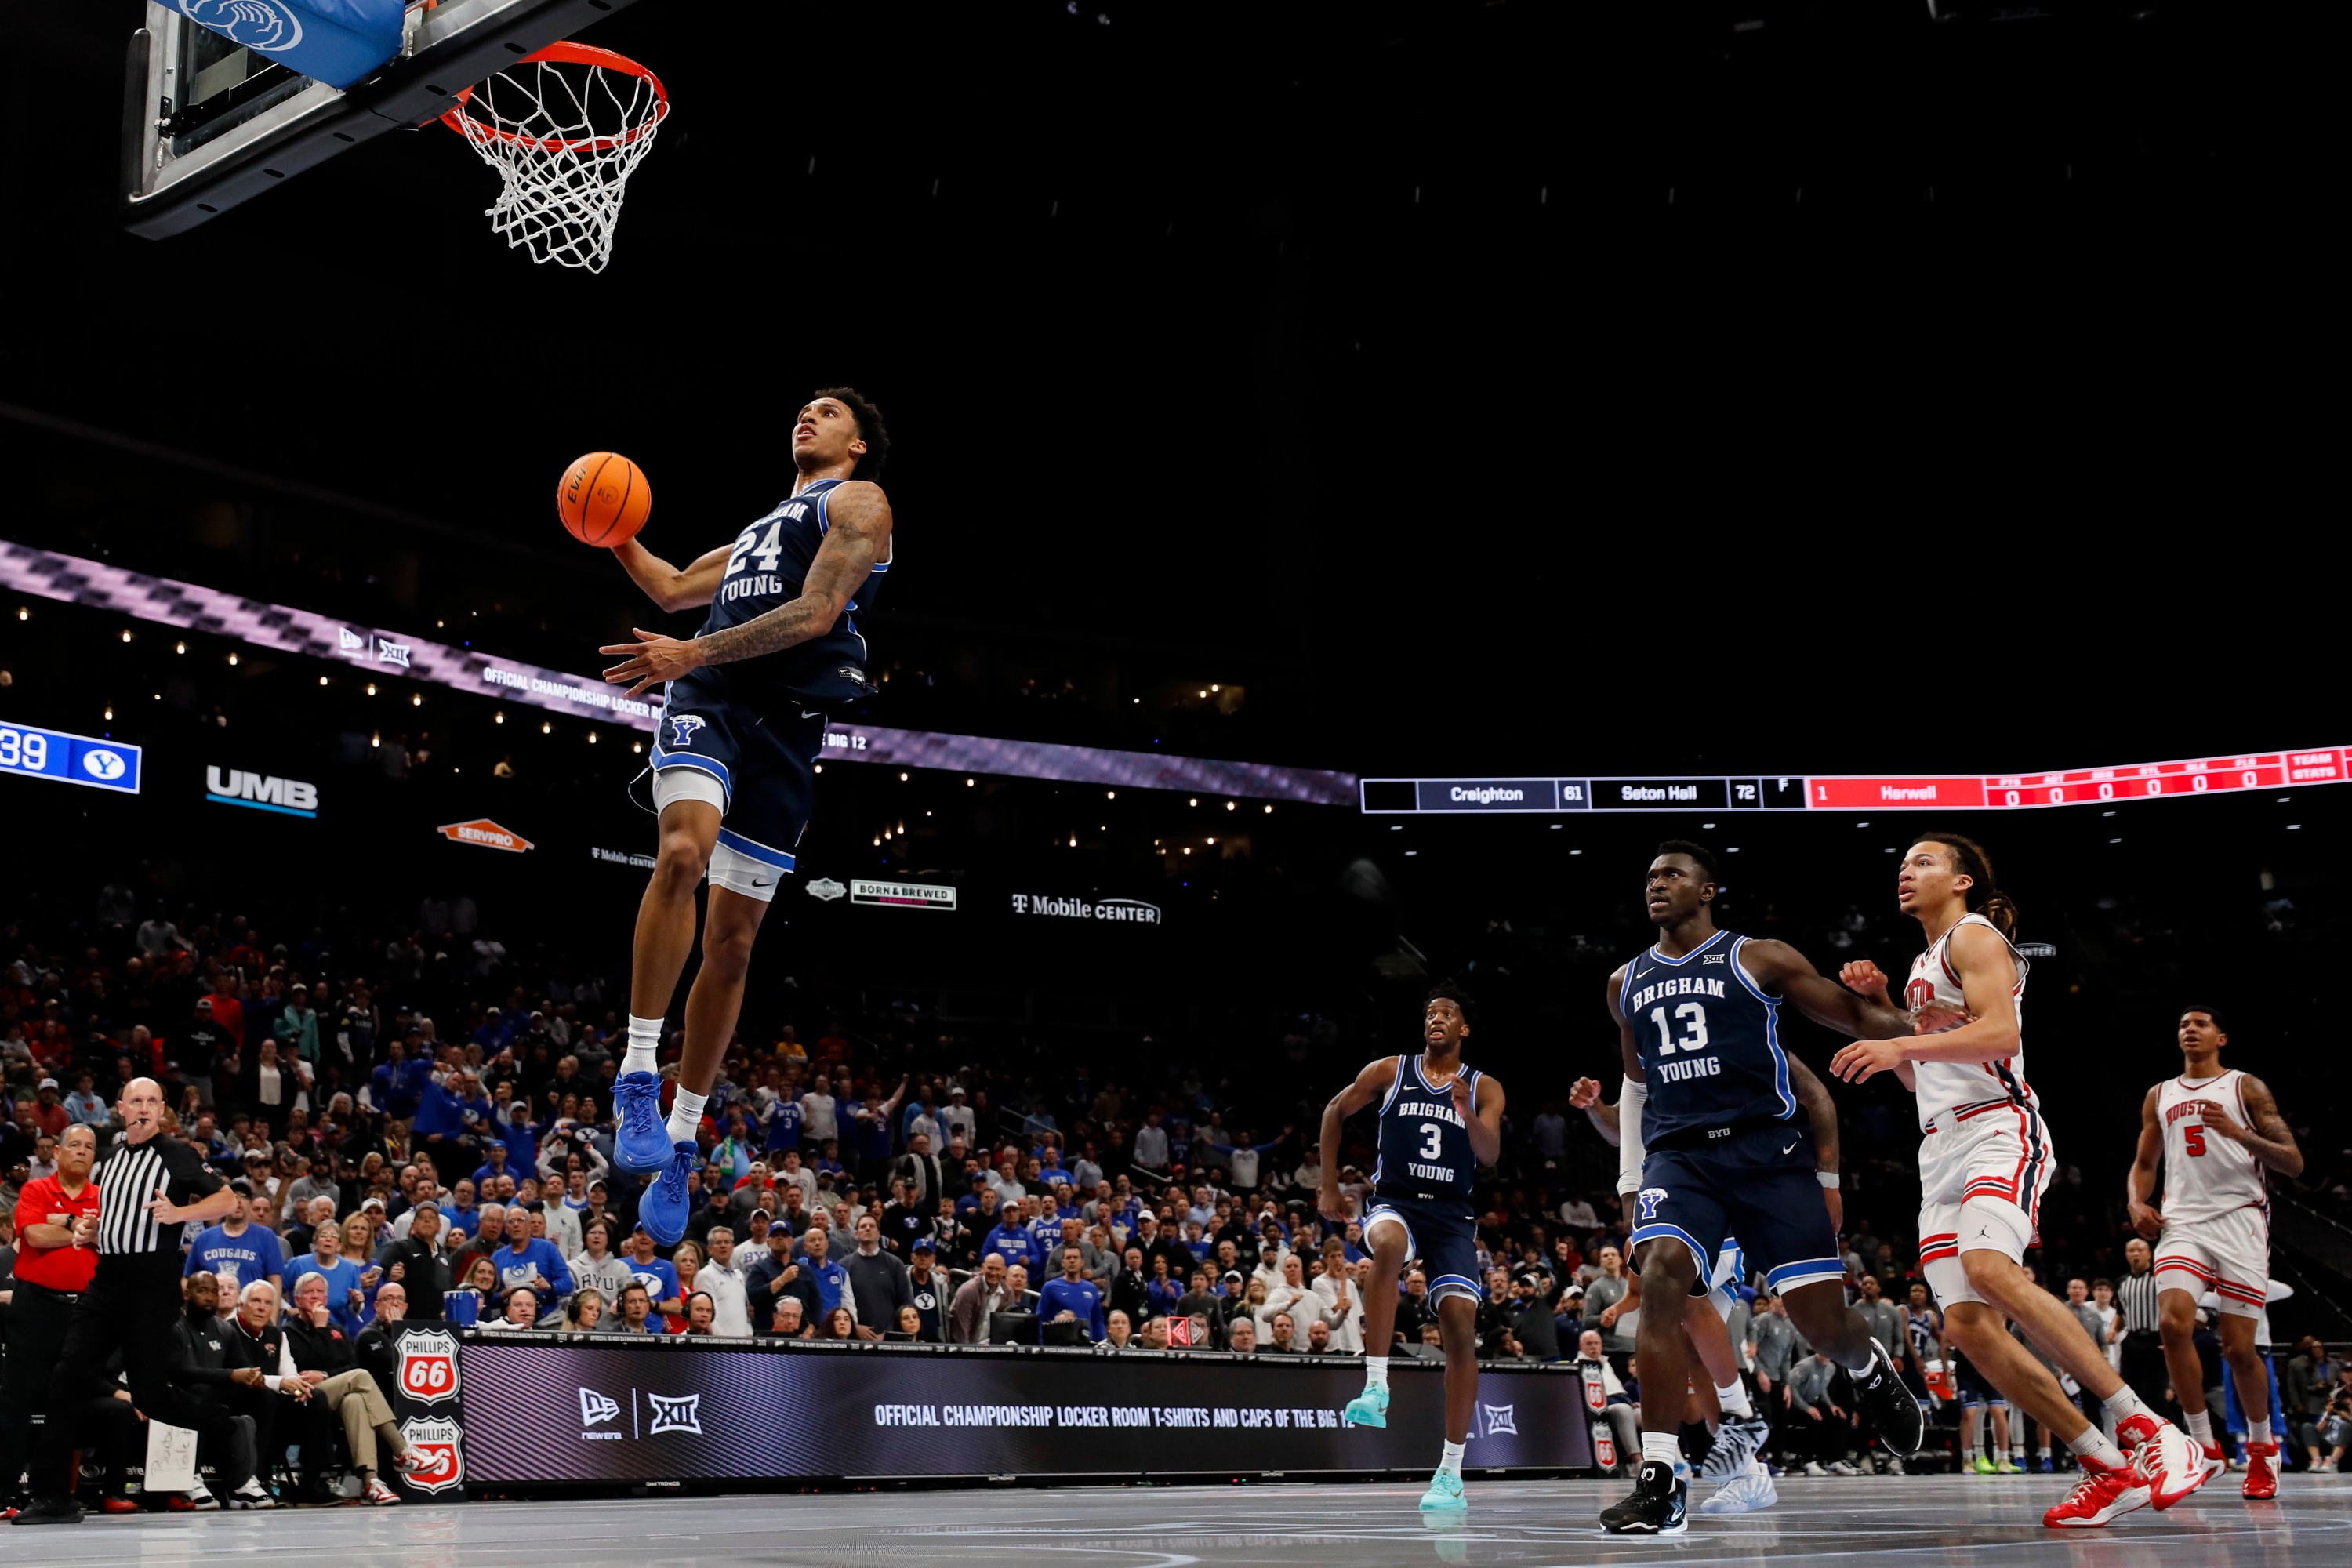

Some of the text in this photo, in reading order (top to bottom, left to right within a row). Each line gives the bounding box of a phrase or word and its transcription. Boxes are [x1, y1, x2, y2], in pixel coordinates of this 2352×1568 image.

[724, 521, 782, 579] 24
[721, 574, 782, 605] YOUNG
[483, 667, 529, 690] OFFICIAL
[532, 678, 611, 708] CHAMPIONSHIP
[612, 697, 650, 717] LOCKER
[828, 734, 848, 748] BIG
[851, 736, 866, 750] 12
[0, 728, 47, 771] 39
[2292, 753, 2332, 766] TEAM
[2292, 766, 2336, 780] STATS
[206, 765, 318, 811] UMB
[1450, 779, 1788, 804] Creighton 61 Seton Hall 72 F
[1817, 785, 1937, 800] 1 Harwell
[2005, 771, 2257, 806] 0 0 0 0 0 0
[458, 826, 514, 847] SERVPRO
[601, 848, 628, 864] Mobile
[860, 885, 948, 899] BORN & BREWED
[1032, 895, 1092, 918] Mobile
[1095, 905, 1156, 923] CENTER
[2018, 947, 2053, 956] ENTER
[1632, 977, 1726, 1014] BRIGHAM
[1650, 1002, 1708, 1056] 13
[1658, 1057, 1721, 1083] YOUNG
[777, 1109, 799, 1119] BYU
[2166, 1099, 2223, 1127] HOUST
[785, 1119, 792, 1129] 3
[1708, 1128, 1730, 1138] BYU
[1420, 1123, 1442, 1160] 3
[2184, 1125, 2207, 1157] 5
[1408, 1163, 1454, 1182] YOUNG
[1036, 1228, 1061, 1239] BYU
[204, 1247, 256, 1261] COUGARS
[1044, 1239, 1053, 1251] 3
[406, 1341, 450, 1353] PHILLIPS
[408, 1360, 448, 1388] 66
[1589, 1385, 1602, 1403] 66
[875, 1404, 941, 1426] OFFICIAL
[943, 1405, 1053, 1427] CHAMPIONSHIP
[1057, 1406, 1110, 1427] LOCKER
[1112, 1407, 1151, 1427] ROOM
[1152, 1407, 1210, 1428] T-SHIRTS
[1213, 1408, 1238, 1428] AND
[1240, 1408, 1272, 1428] CAPS
[1275, 1409, 1290, 1428] OF
[1291, 1409, 1316, 1428] THE
[1317, 1409, 1338, 1428] BIG
[409, 1428, 454, 1441] PHILLIPS
[1599, 1443, 1613, 1461] 66
